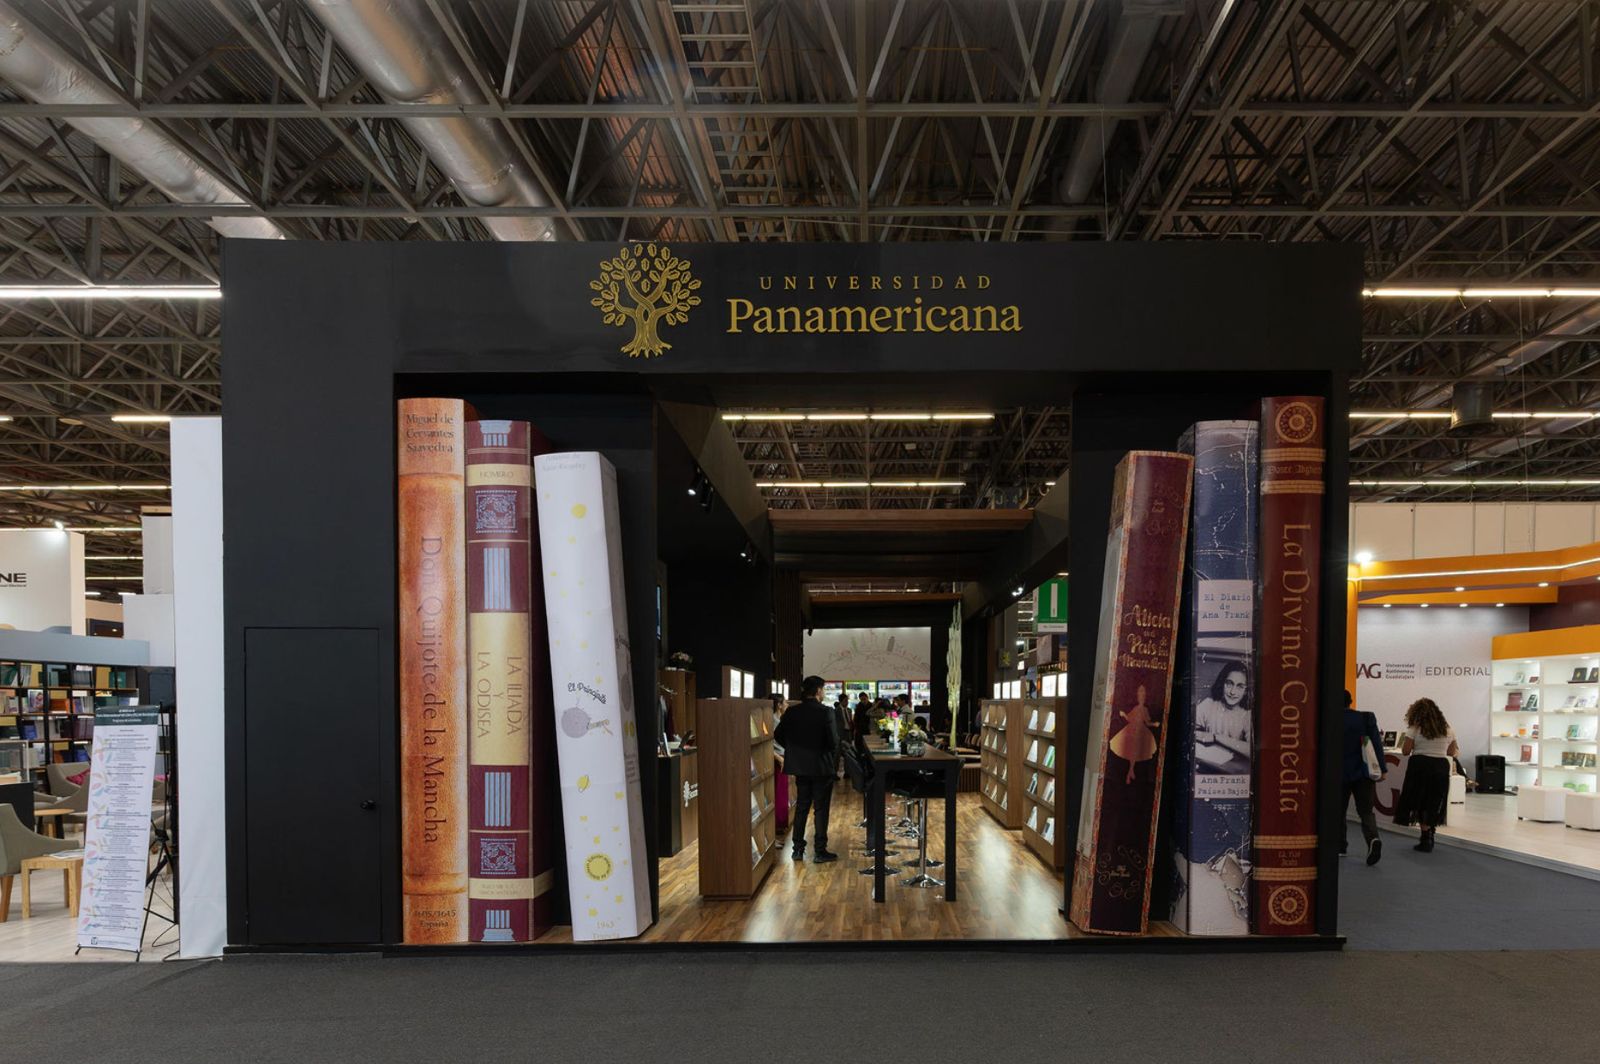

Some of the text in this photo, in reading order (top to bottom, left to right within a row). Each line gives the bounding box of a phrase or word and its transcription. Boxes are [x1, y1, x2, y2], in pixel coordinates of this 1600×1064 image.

[759, 275, 991, 291] UNIVERSIDAD
[726, 297, 1024, 334] Panamericana
[406, 413, 454, 425] Miguel de
[406, 428, 454, 439] Cervantes
[406, 442, 454, 453] Saavedra
[1282, 523, 1312, 558] La
[1356, 663, 1491, 679] AG EDITORIAL
[415, 536, 448, 844] Don Quijote de la Mancha
[477, 651, 492, 738] LA ODISEA
[493, 691, 505, 700] Y
[506, 655, 523, 736] LA ILIADA
[1201, 776, 1247, 784] Ana Frank
